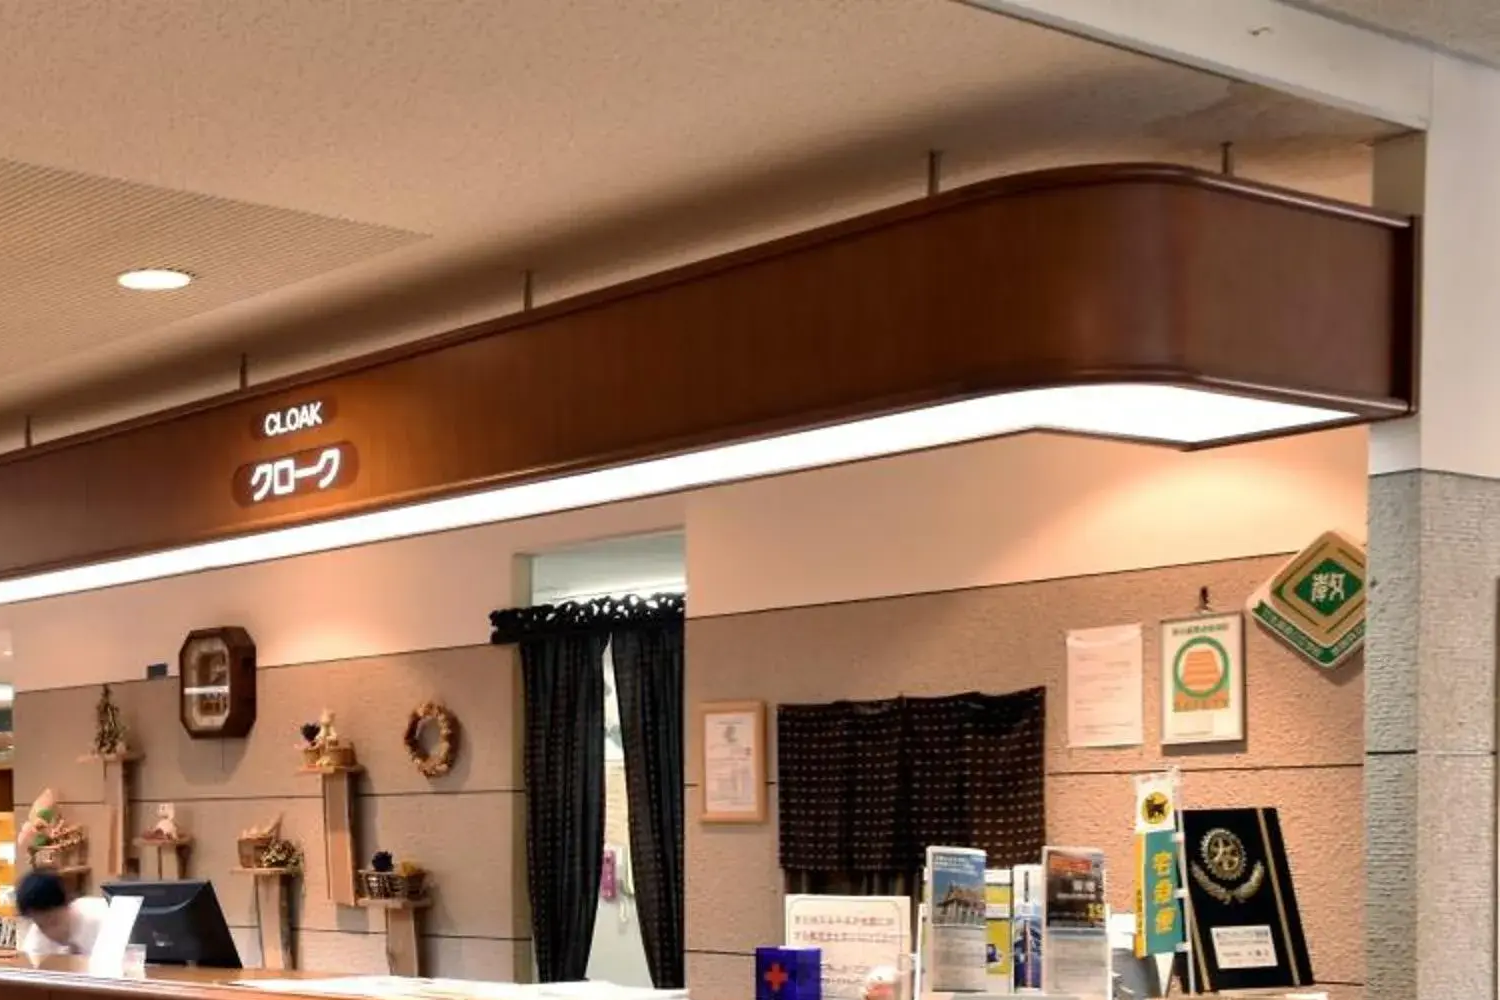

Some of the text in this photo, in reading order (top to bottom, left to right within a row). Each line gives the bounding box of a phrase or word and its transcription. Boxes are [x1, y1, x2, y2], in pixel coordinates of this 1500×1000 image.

[265, 401, 322, 436] CLOAK
[251, 448, 341, 501] クローク
